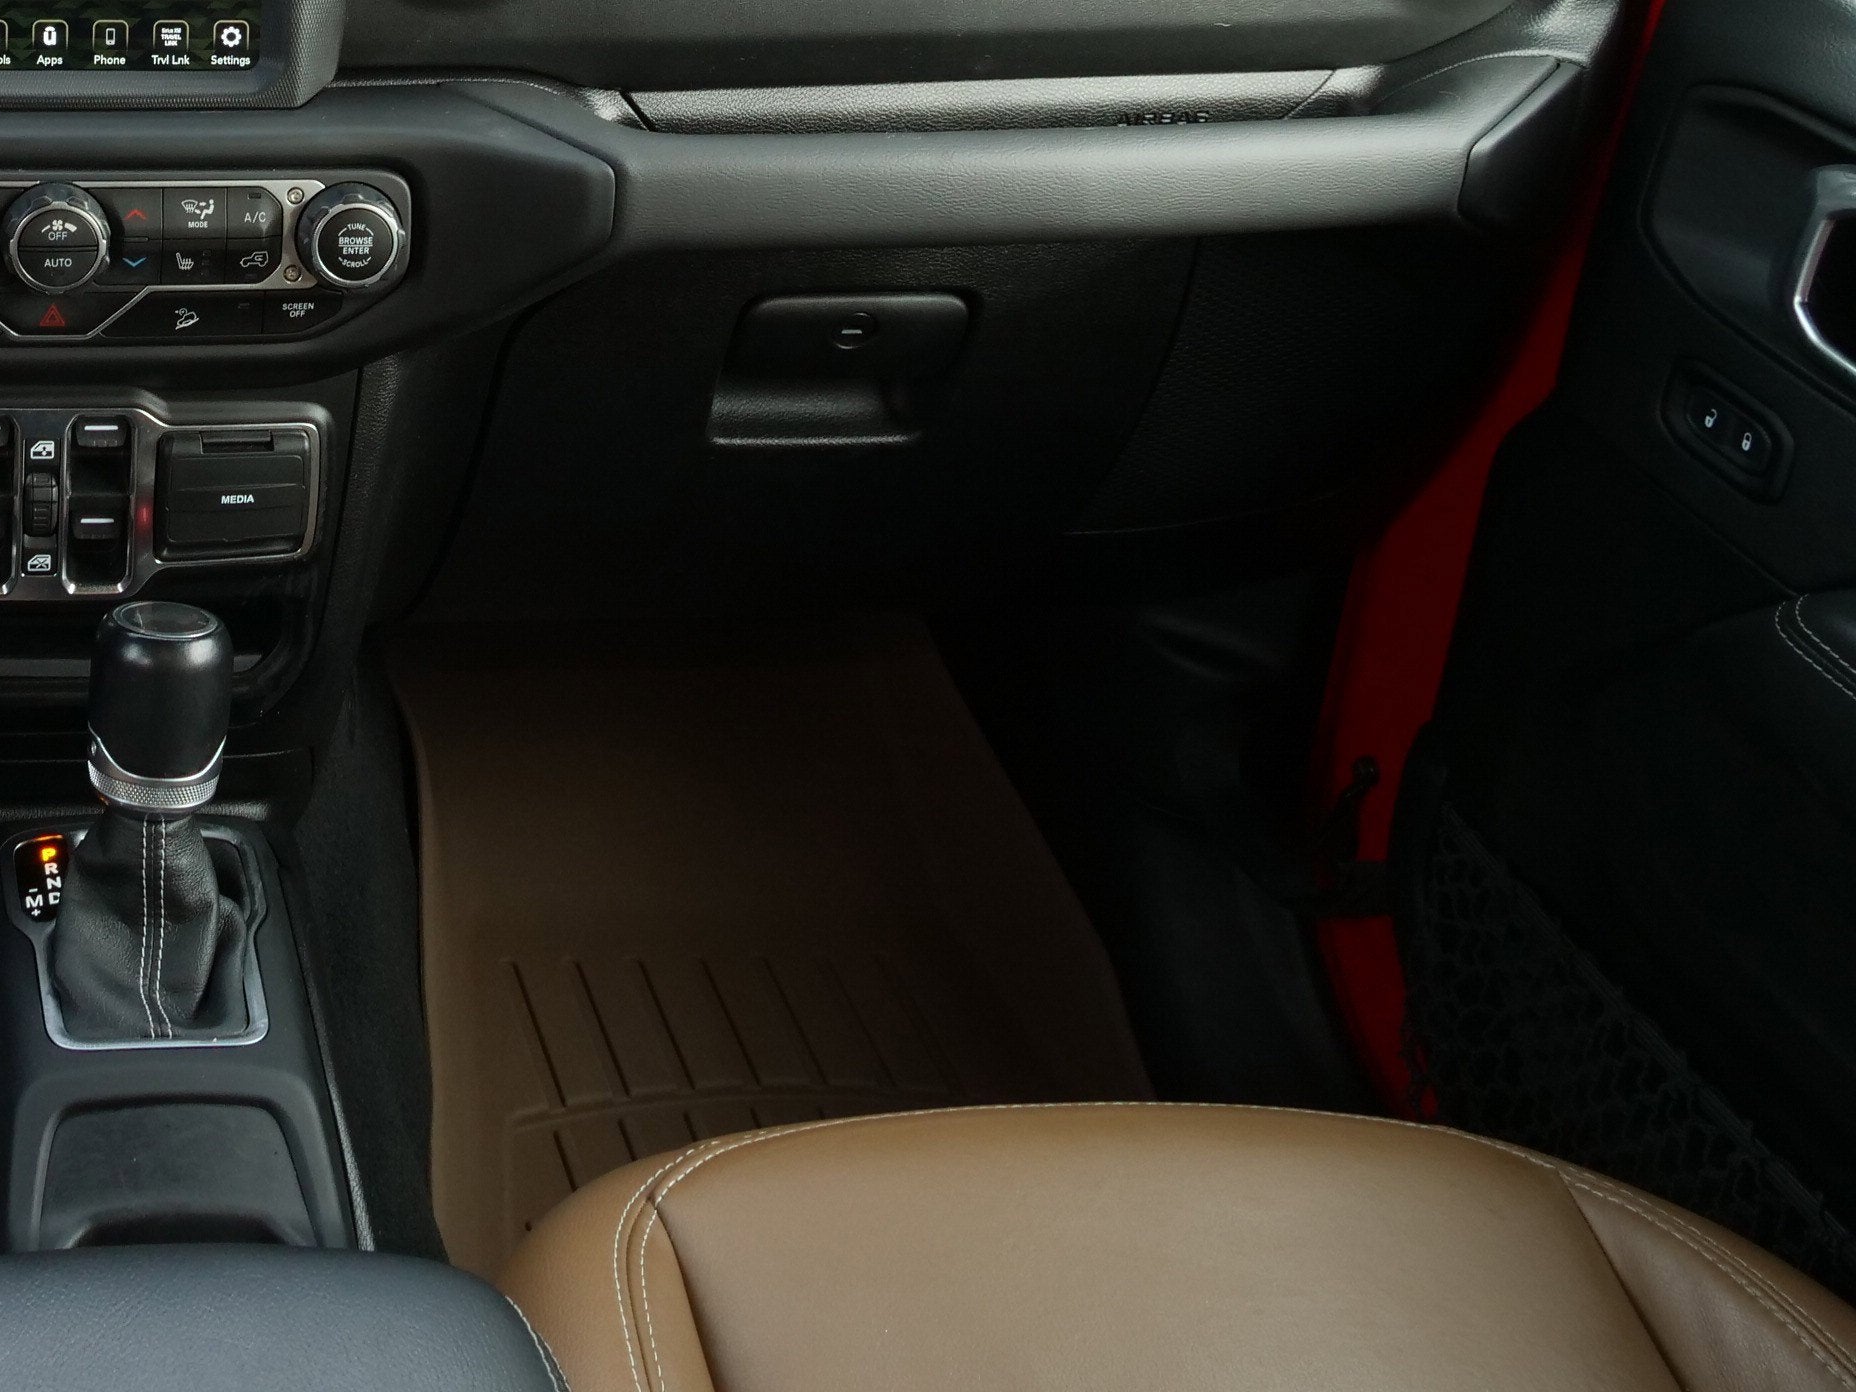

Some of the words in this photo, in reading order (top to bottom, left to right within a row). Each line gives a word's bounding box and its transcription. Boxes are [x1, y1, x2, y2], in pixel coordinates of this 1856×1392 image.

[37, 54, 63, 68] Apps
[93, 54, 126, 66] Phone
[151, 54, 169, 65] Trvl
[172, 54, 190, 65] Lnk
[211, 54, 251, 68] Settings
[244, 211, 266, 224] A/C
[48, 231, 67, 241] OFF
[44, 258, 72, 267] AUTO
[342, 260, 367, 268] SCROLL
[221, 494, 254, 504] MEDIA
[41, 848, 57, 861] P
[44, 862, 58, 875] R
[46, 876, 61, 889] N
[25, 894, 43, 908] M
[48, 892, 60, 905] D
